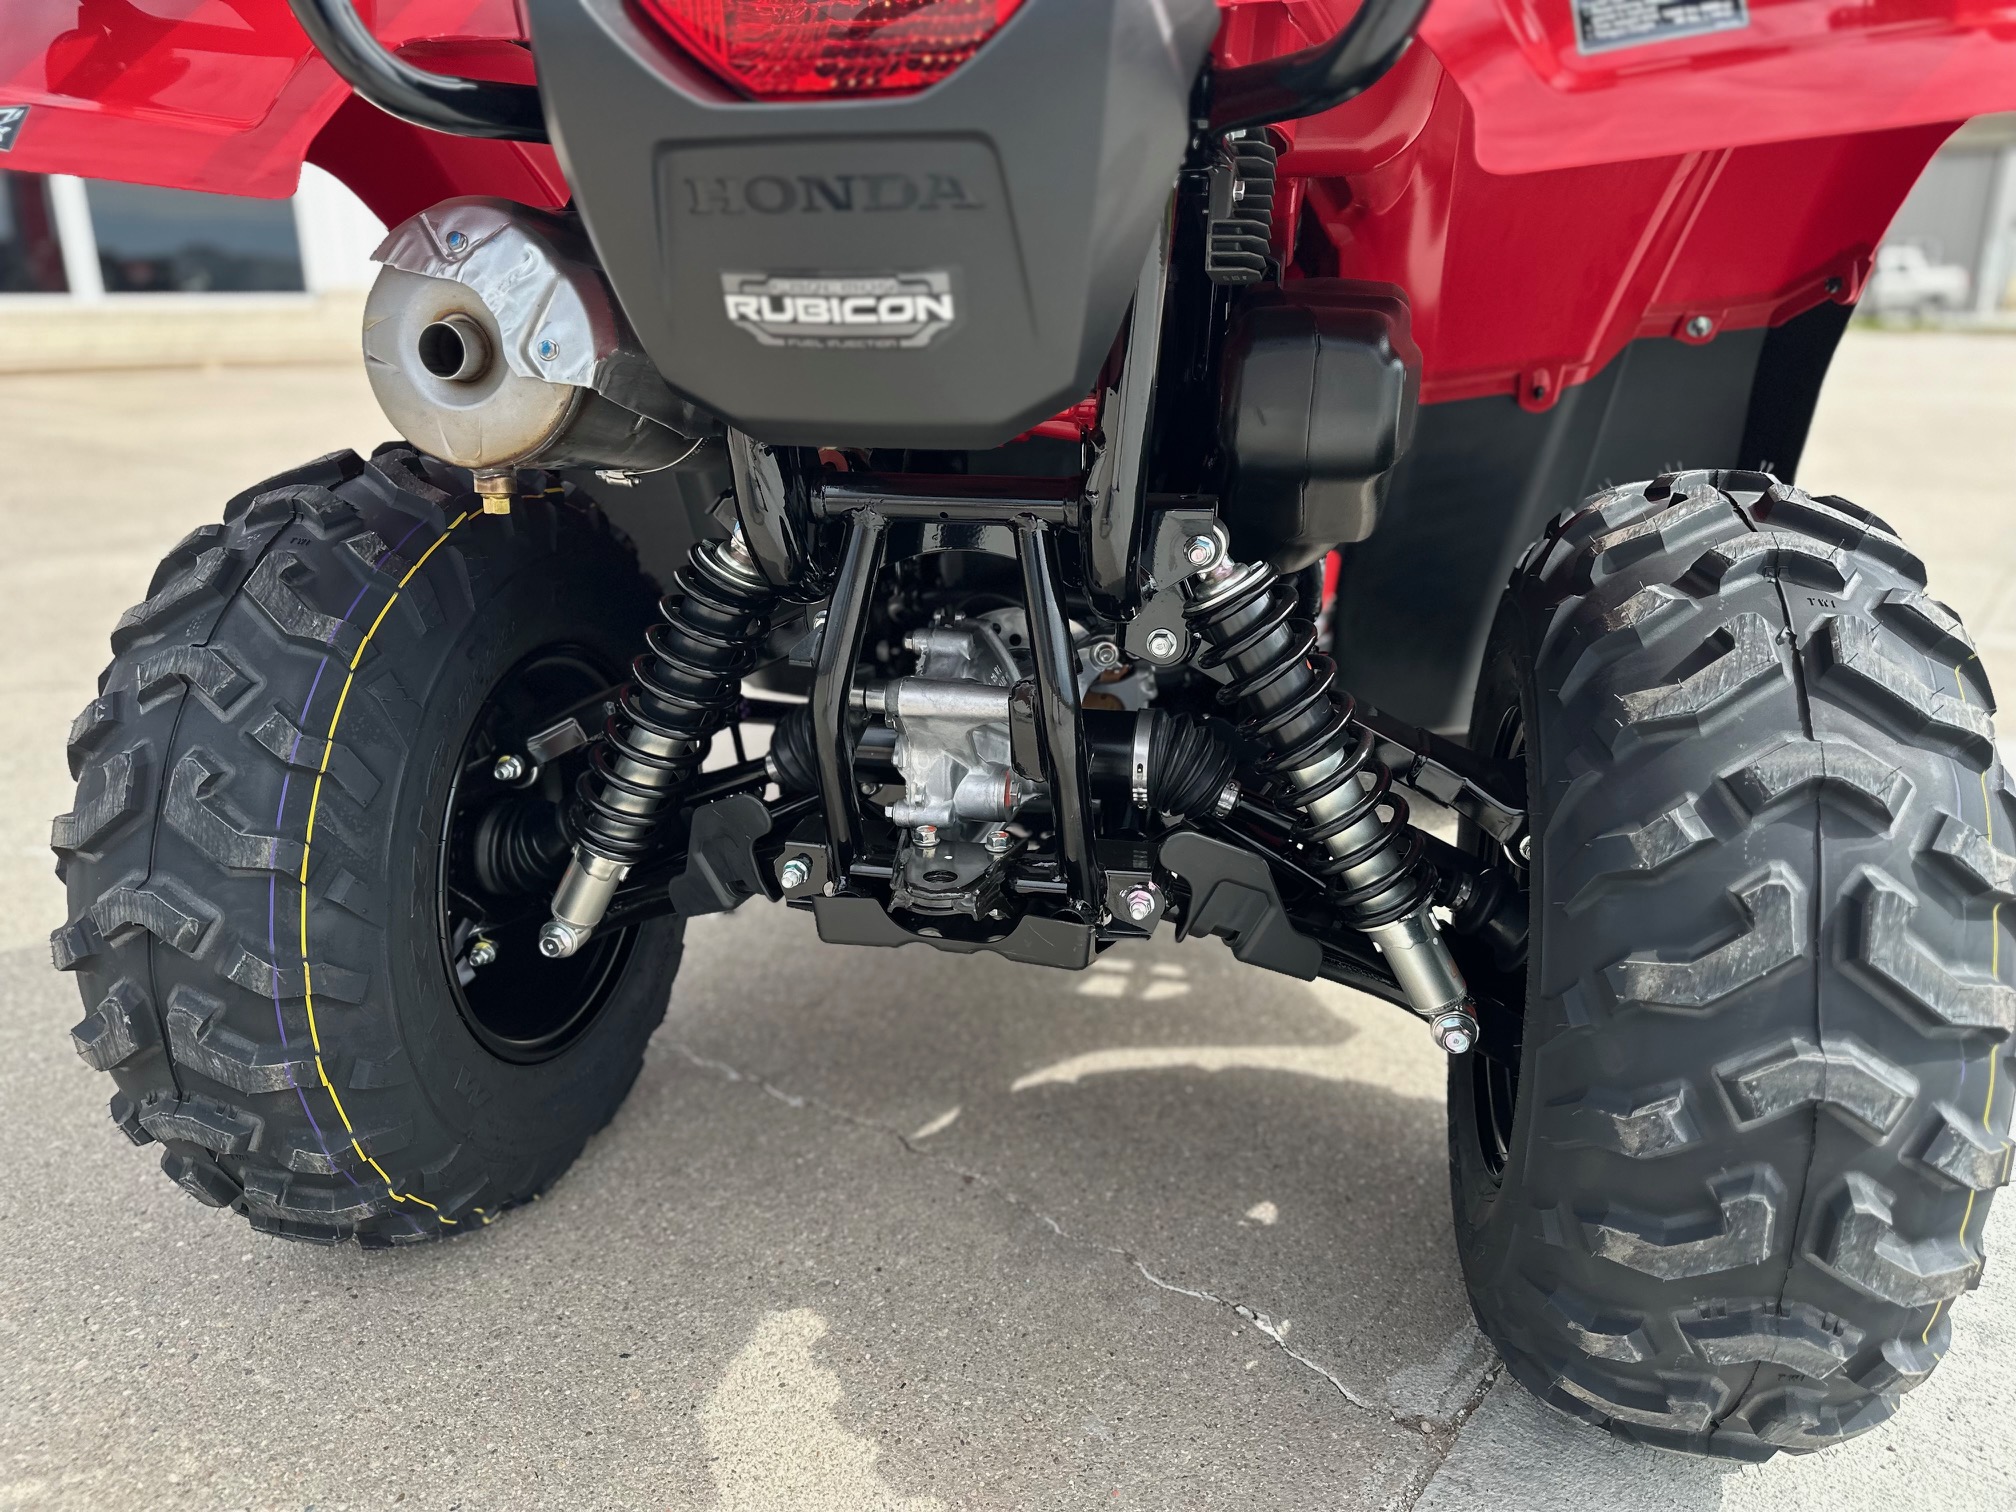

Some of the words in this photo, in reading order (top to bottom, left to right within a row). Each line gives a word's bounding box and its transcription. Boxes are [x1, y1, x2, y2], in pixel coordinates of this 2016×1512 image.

[683, 172, 987, 215] HONDA
[724, 294, 954, 323] RUBICON
[1806, 597, 1836, 609] TWI
